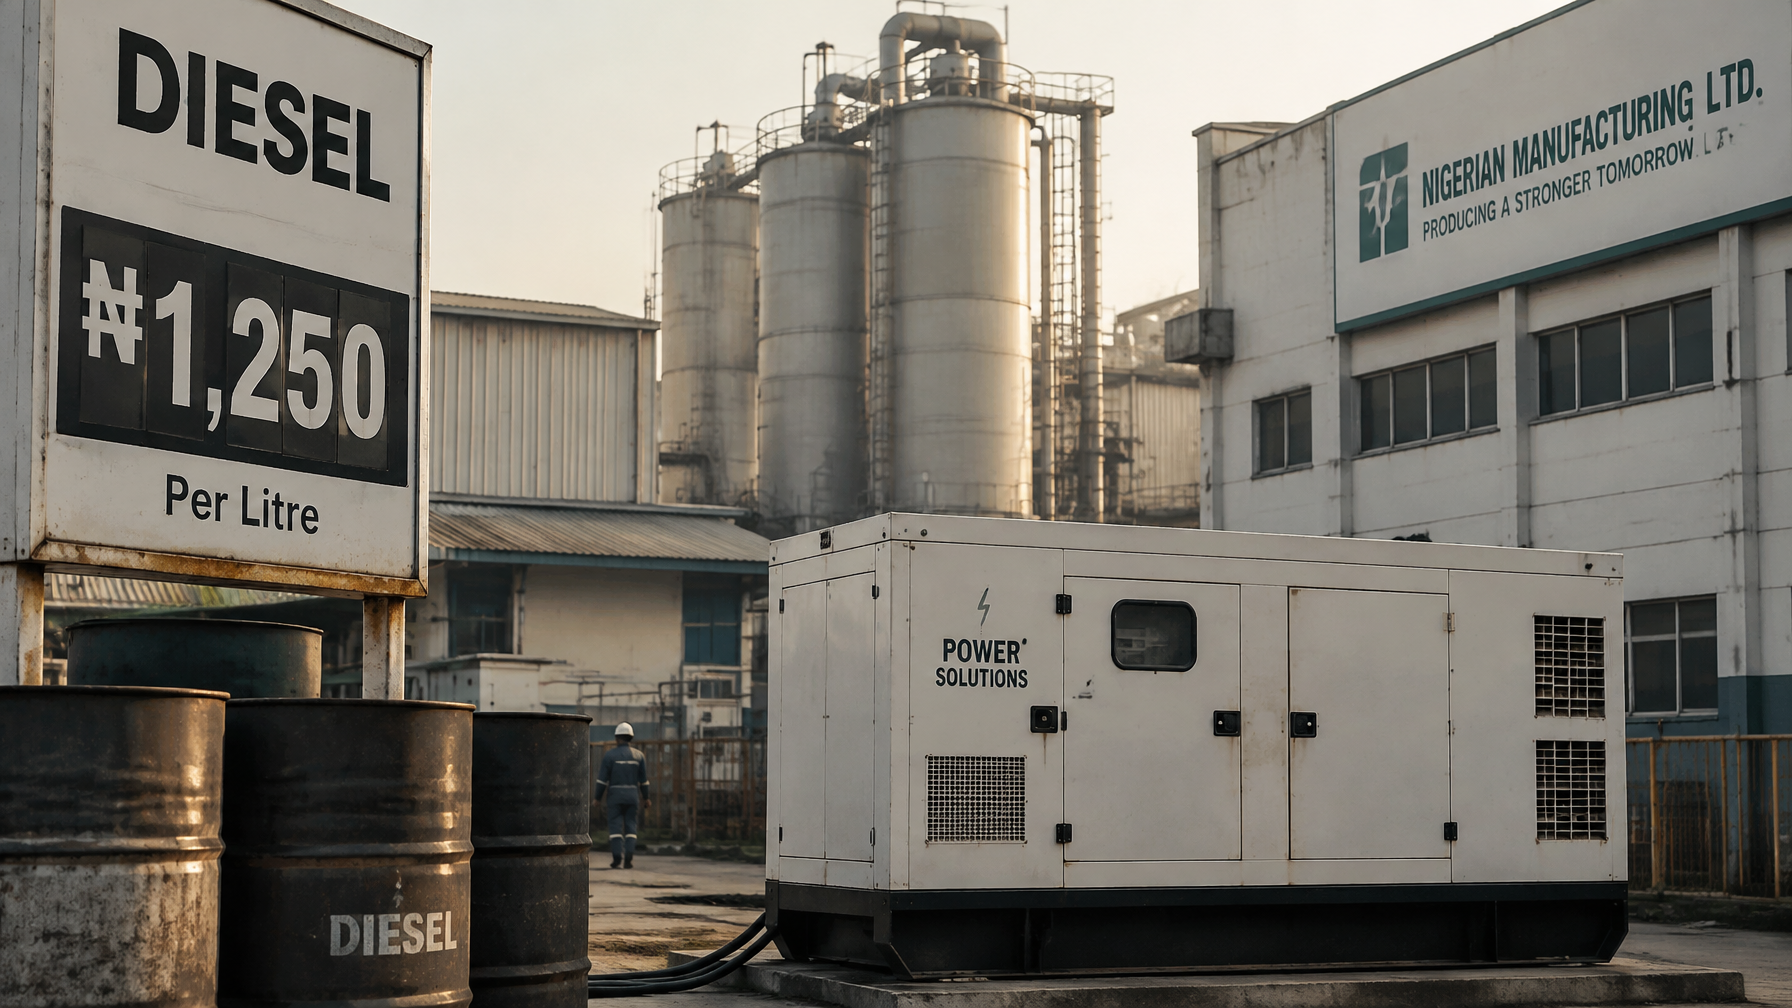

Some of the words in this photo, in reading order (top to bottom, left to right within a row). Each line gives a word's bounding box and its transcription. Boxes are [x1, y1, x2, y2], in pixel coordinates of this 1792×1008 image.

[117, 27, 391, 203] DIESEL
[1422, 144, 1506, 208] NIGERIAN
[1513, 80, 1694, 179] MANUFACTURING
[1706, 58, 1763, 115] LTD.
[1423, 200, 1497, 242] PRODUCING
[1501, 196, 1511, 218] A
[1515, 169, 1592, 214] STRONGER
[1596, 136, 1694, 187] TOMORROW
[166, 473, 229, 522] Per
[241, 485, 320, 535] Litre
[935, 667, 1029, 689] SOLUTIONS
[942, 638, 1021, 665] POWER
[329, 910, 458, 957] DIESEL
